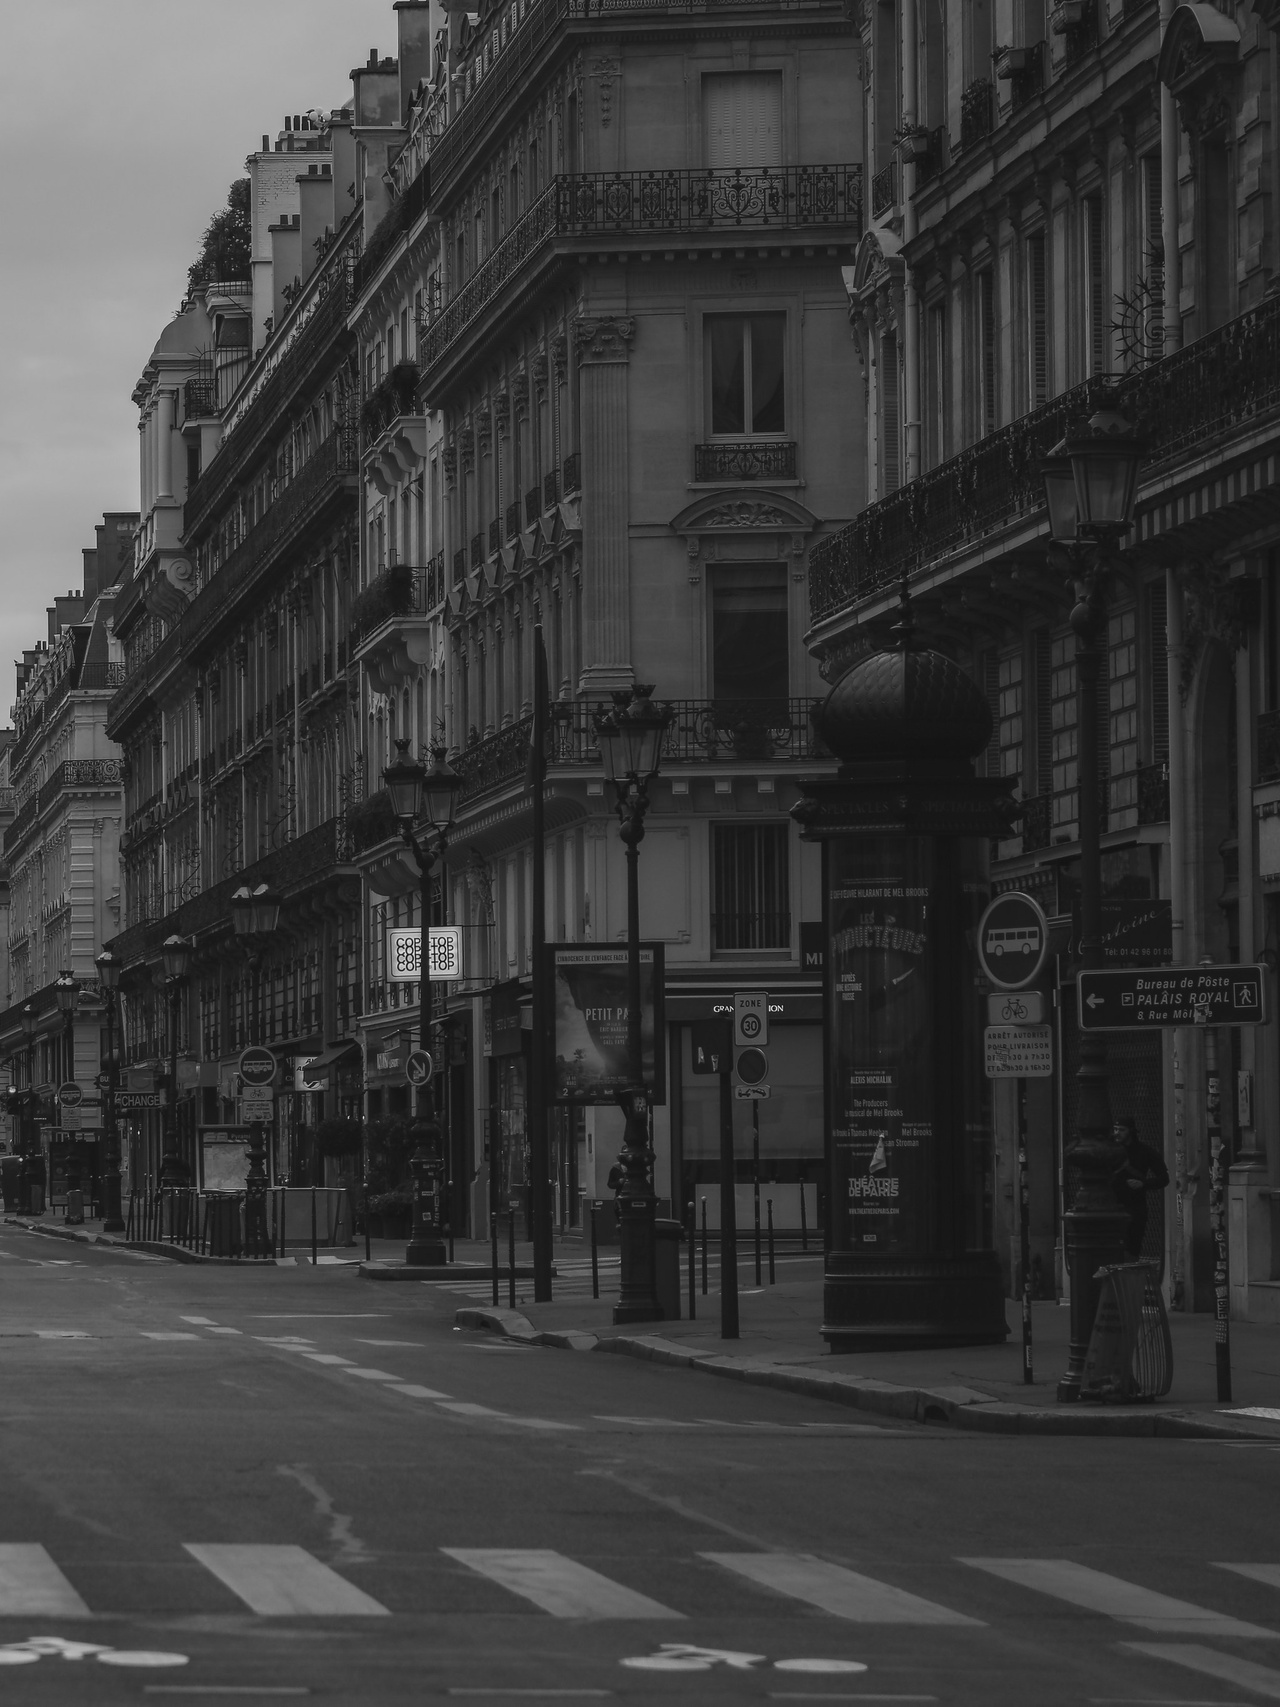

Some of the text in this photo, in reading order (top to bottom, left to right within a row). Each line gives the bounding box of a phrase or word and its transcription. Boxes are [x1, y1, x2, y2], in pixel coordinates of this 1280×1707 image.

[857, 888, 883, 897] HILARANT
[883, 888, 892, 897] DE
[892, 888, 904, 897] MEL
[905, 887, 929, 896] BROOKS
[806, 952, 823, 965] MI
[1136, 979, 1176, 990] Bureau
[1180, 977, 1194, 988] de
[1189, 991, 1230, 1004] ROYAL
[713, 1005, 735, 1013] GRAN
[585, 1007, 629, 1021] PETIT PA
[1148, 1010, 1168, 1019] Rue
[744, 1020, 757, 1031] 30
[987, 1031, 1011, 1040] ARRÊT
[866, 1075, 892, 1084] MICHALIK
[121, 1095, 160, 1107] CHANGE
[854, 1099, 888, 1107] The Producers
[848, 1109, 865, 1117] musical
[866, 1109, 872, 1117] de
[851, 1129, 868, 1137] Thomas
[901, 1128, 932, 1136] Mel Brooks
[895, 1138, 920, 1147] Stroman
[848, 1175, 899, 1188] THÉÂTRE
[848, 1186, 899, 1197] DE PARIS
